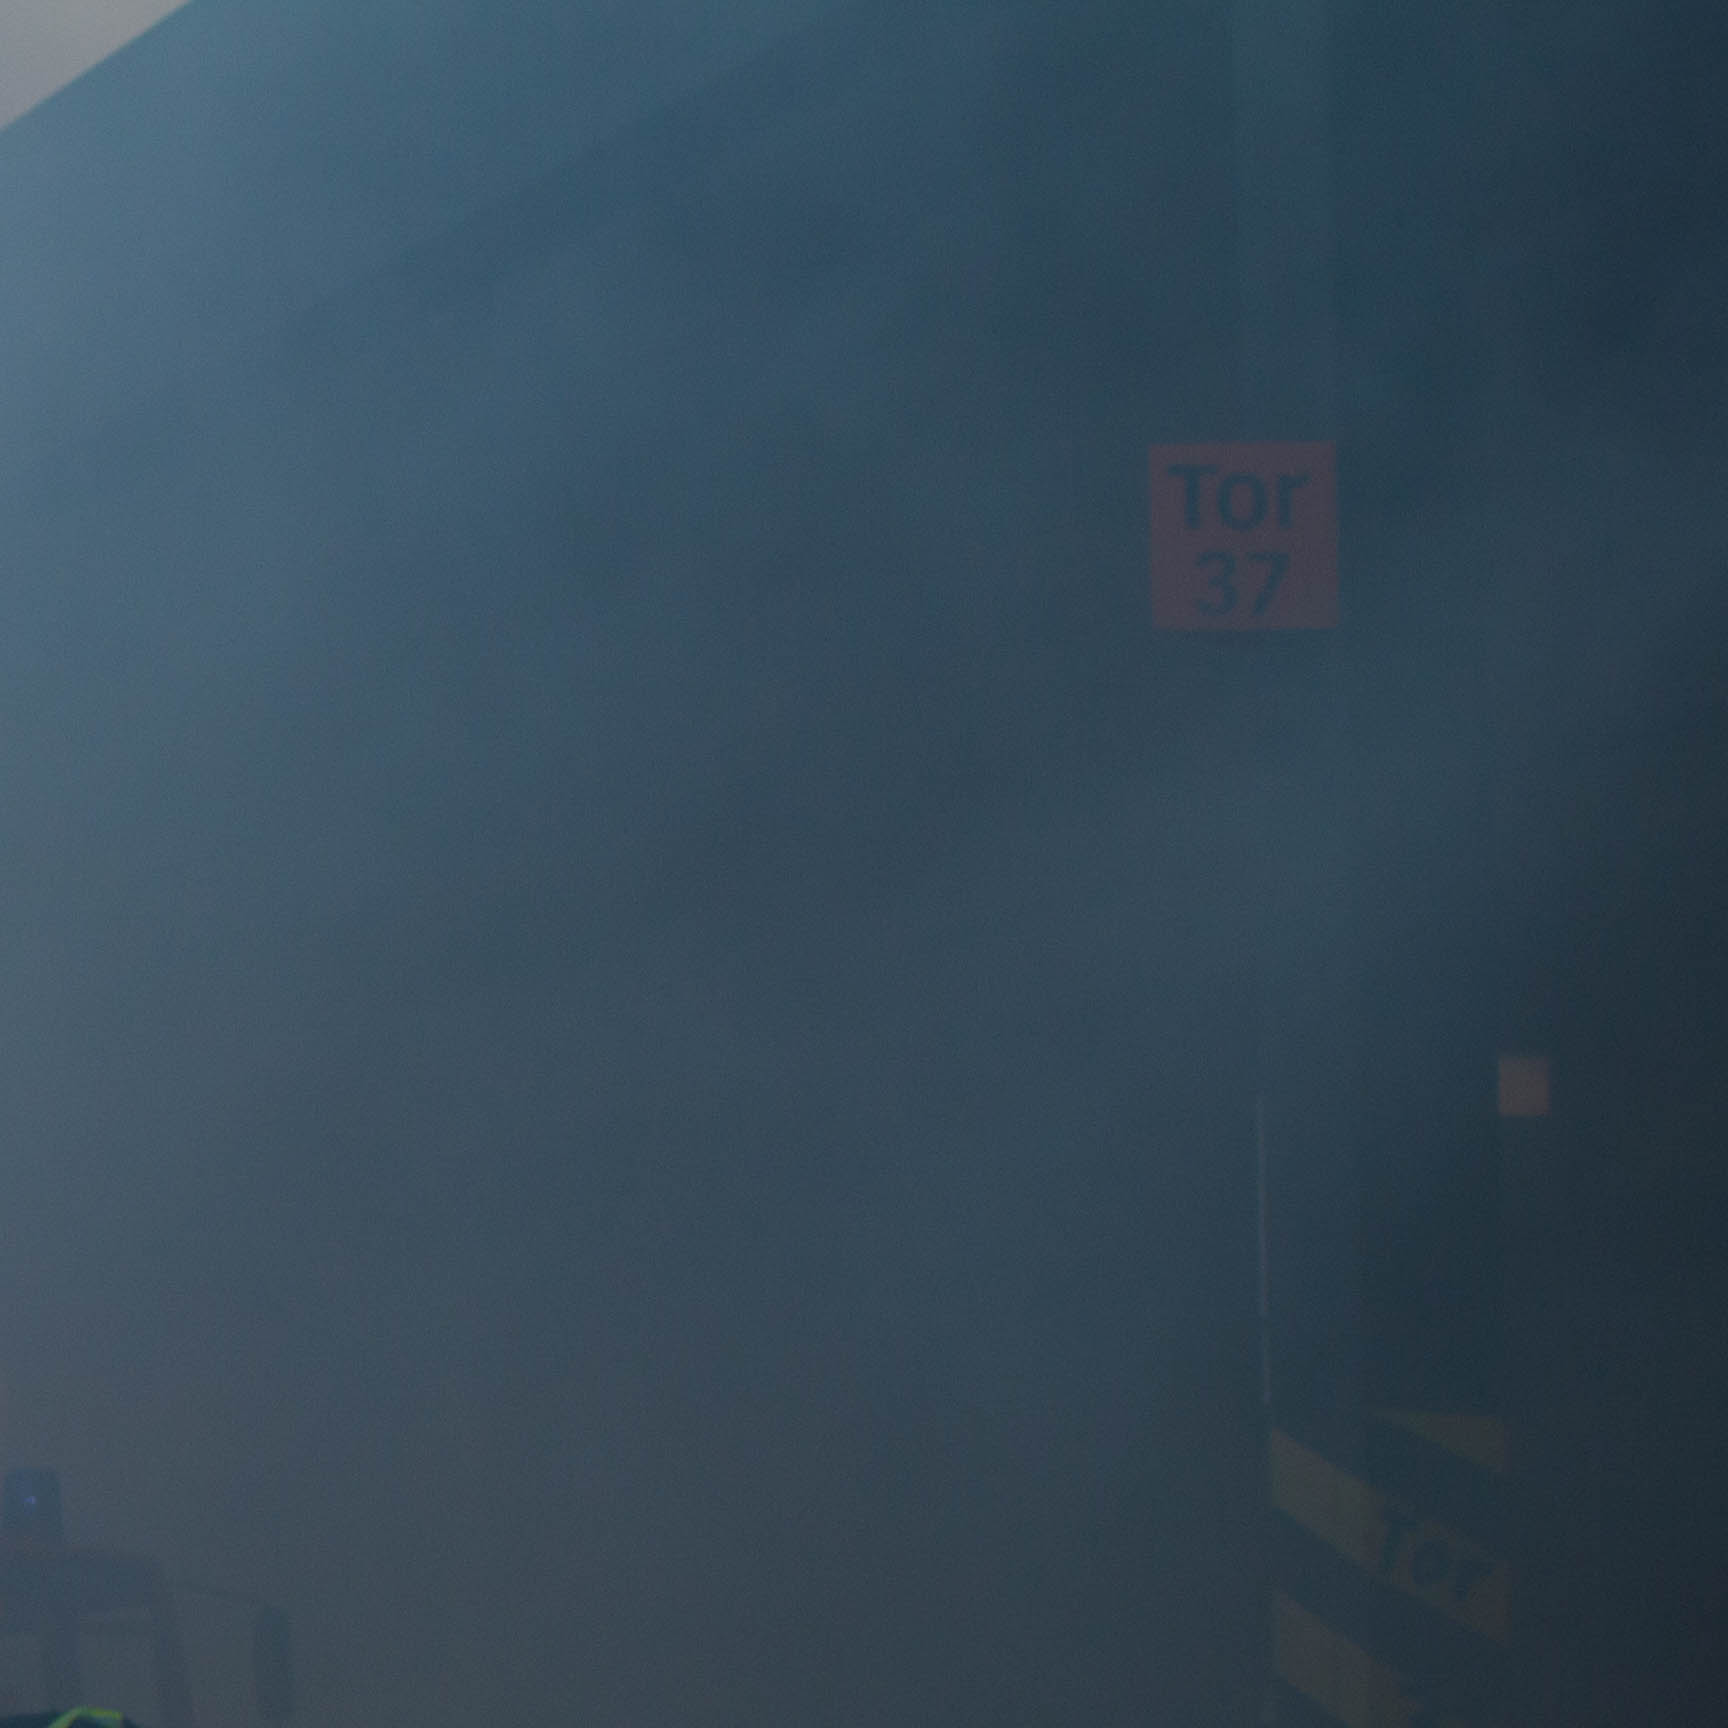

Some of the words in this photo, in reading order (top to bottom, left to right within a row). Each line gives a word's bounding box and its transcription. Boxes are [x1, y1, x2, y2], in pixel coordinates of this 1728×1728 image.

[1166, 463, 1313, 531] Tor
[1196, 550, 1291, 617] 37
[1377, 1507, 1494, 1601] Tor
